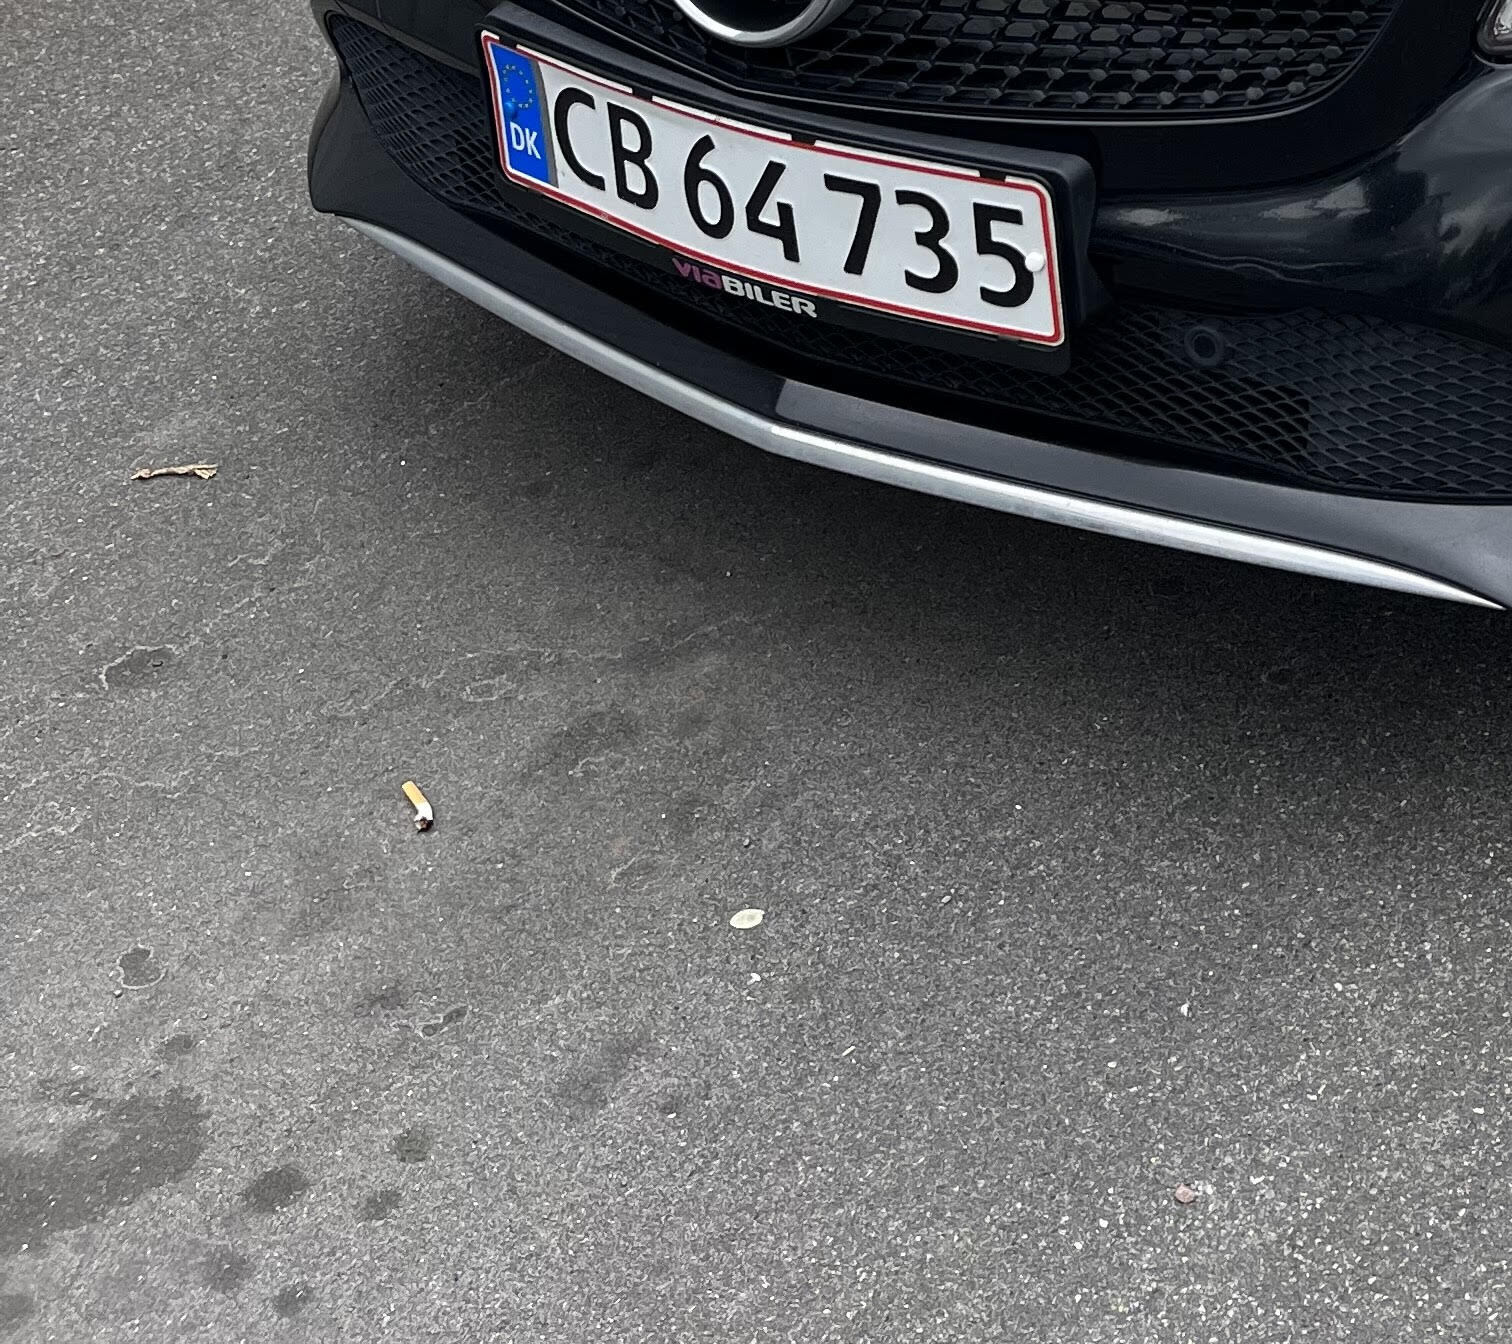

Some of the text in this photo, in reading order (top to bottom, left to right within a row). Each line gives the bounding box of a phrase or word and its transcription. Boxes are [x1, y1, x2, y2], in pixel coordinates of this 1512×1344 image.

[509, 121, 541, 160] DK
[554, 86, 1035, 308] CB 64 735
